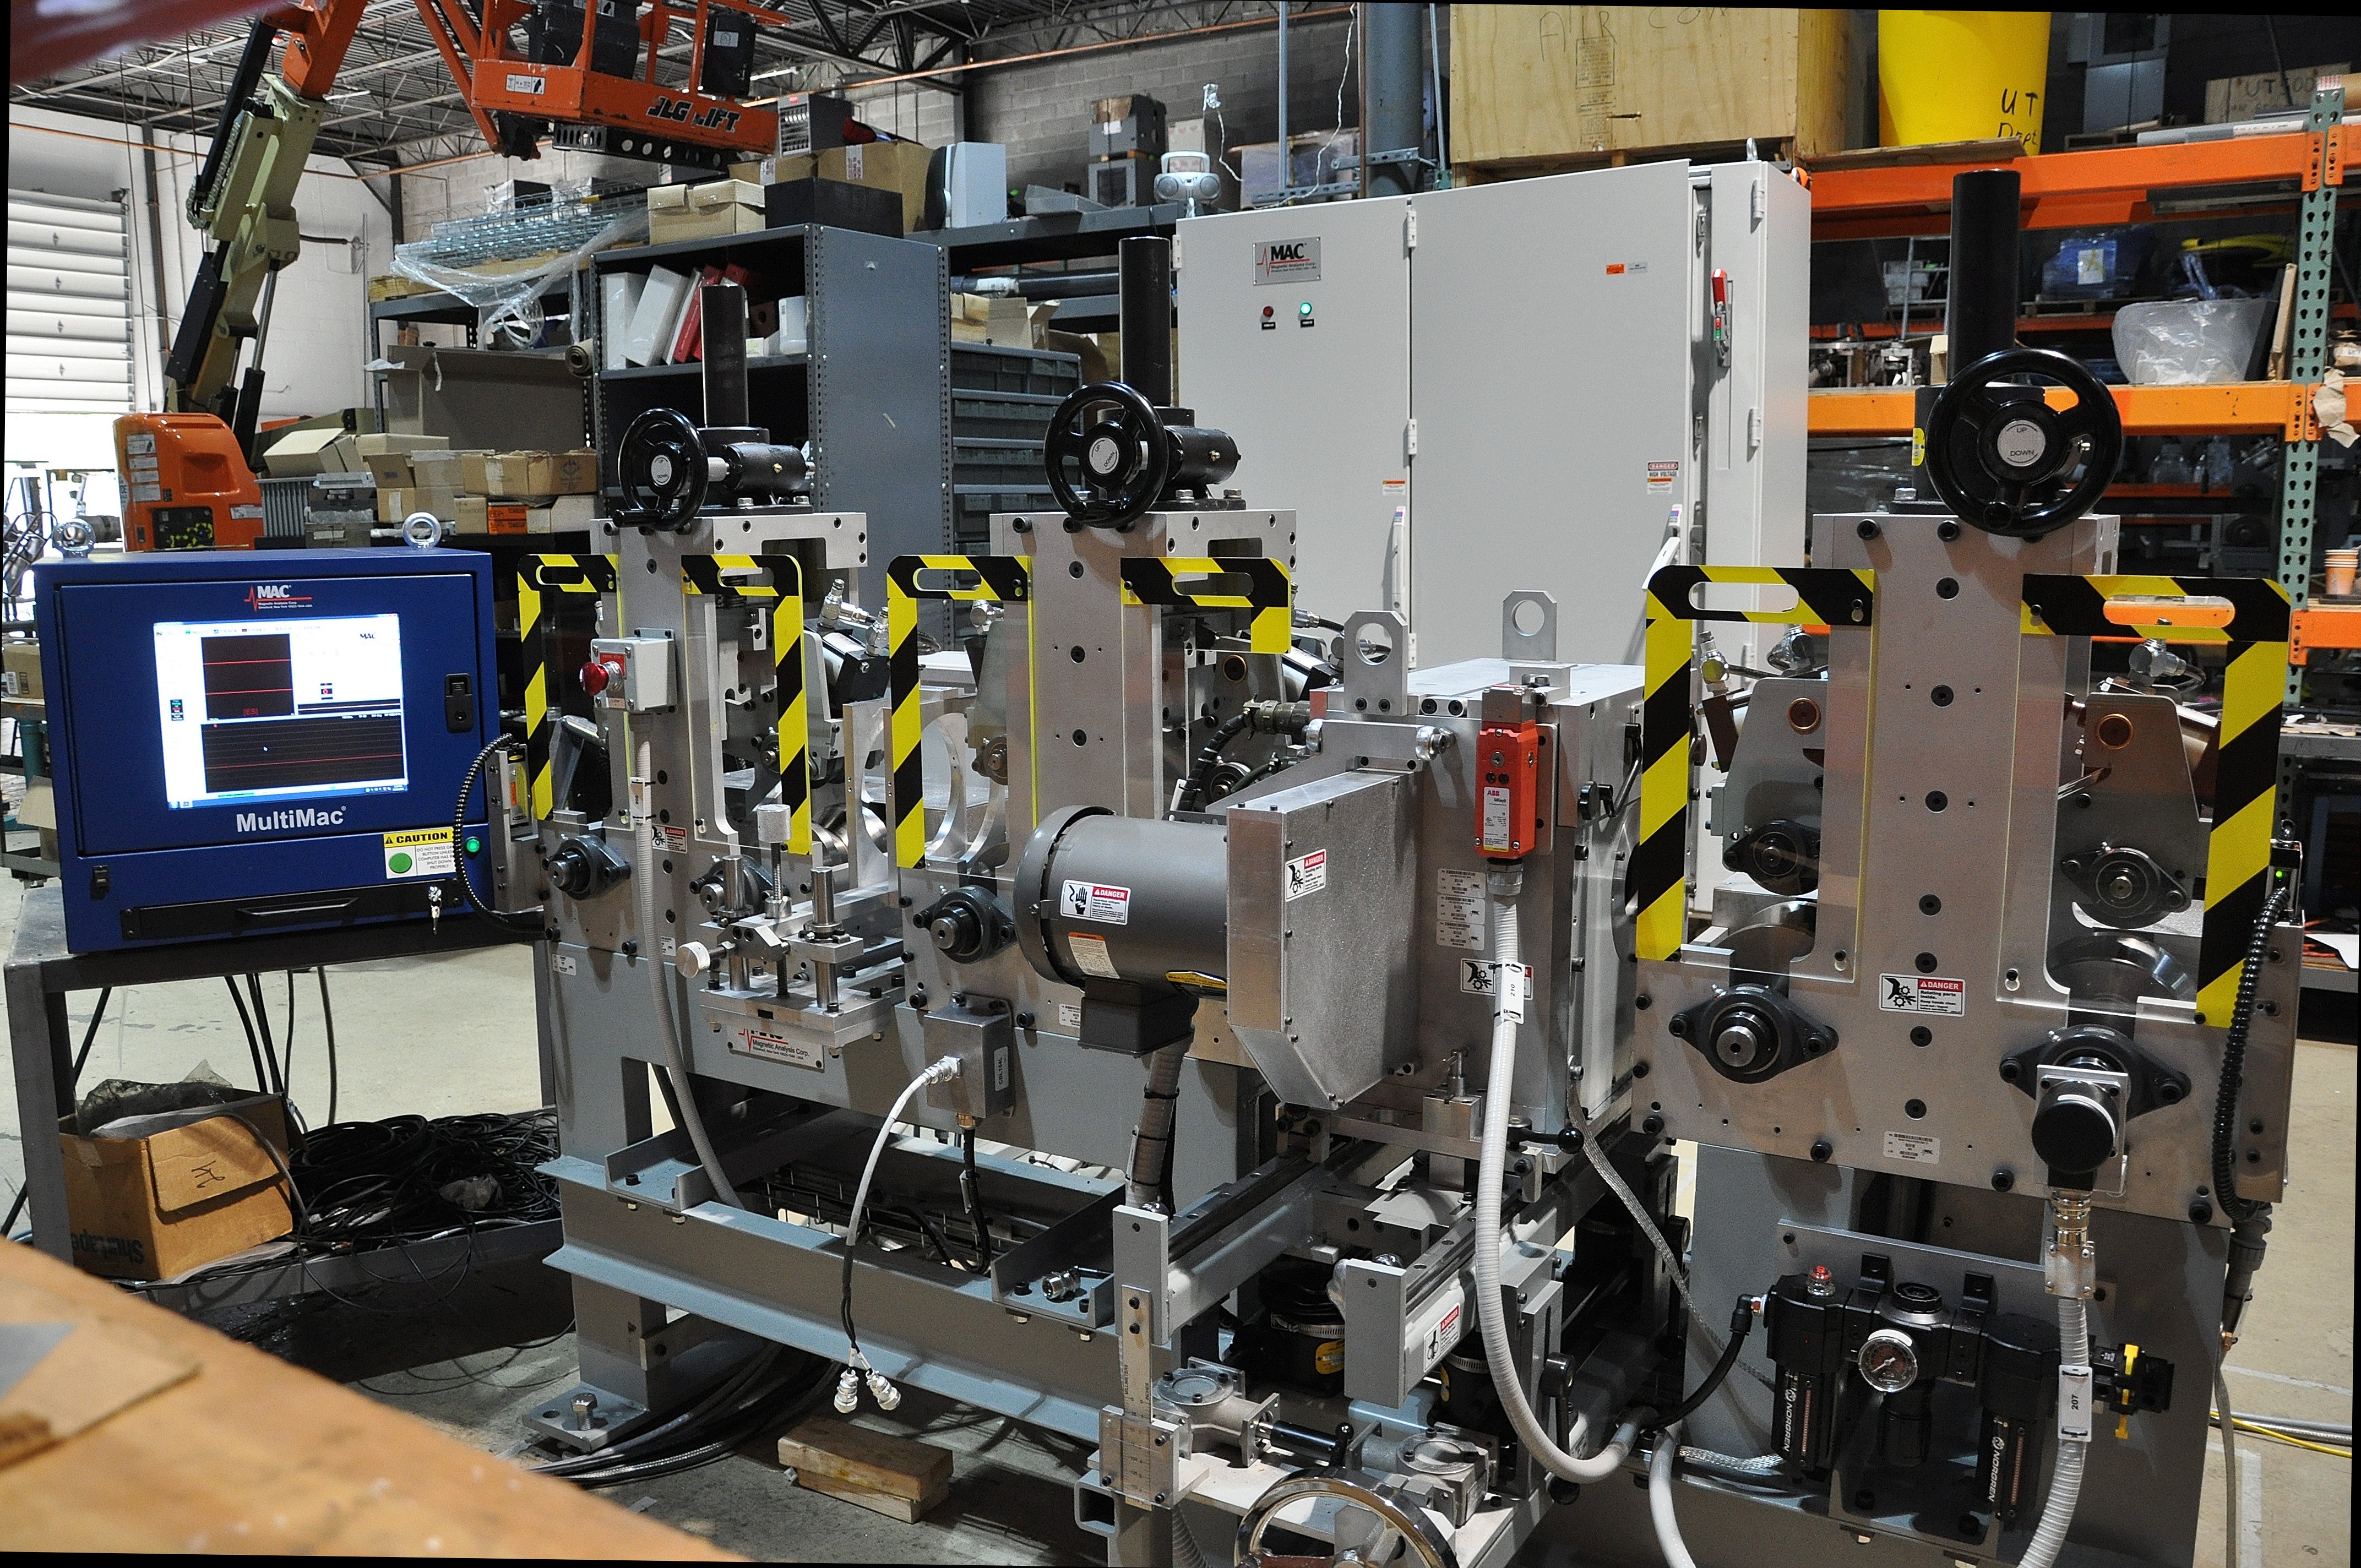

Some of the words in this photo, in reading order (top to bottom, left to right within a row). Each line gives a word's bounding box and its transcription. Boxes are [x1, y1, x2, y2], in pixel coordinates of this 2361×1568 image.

[1539, 11, 1618, 61] AIR
[646, 95, 693, 123] JLG
[1270, 243, 1304, 261] MAC
[1095, 444, 1101, 453] UP
[1103, 451, 1116, 467] DOWN
[257, 585, 290, 599] MAC
[236, 808, 344, 832] MultiMac
[396, 832, 448, 843] CAUTION
[1100, 889, 1125, 899] DANGER
[1928, 981, 1959, 990] DANGER
[752, 1039, 774, 1049] Magnetic
[775, 1044, 796, 1053] Analysis
[796, 1048, 810, 1057] Corp.
[1784, 1402, 1793, 1452] NORGREN
[1987, 1450, 2000, 1502] NORGREN
